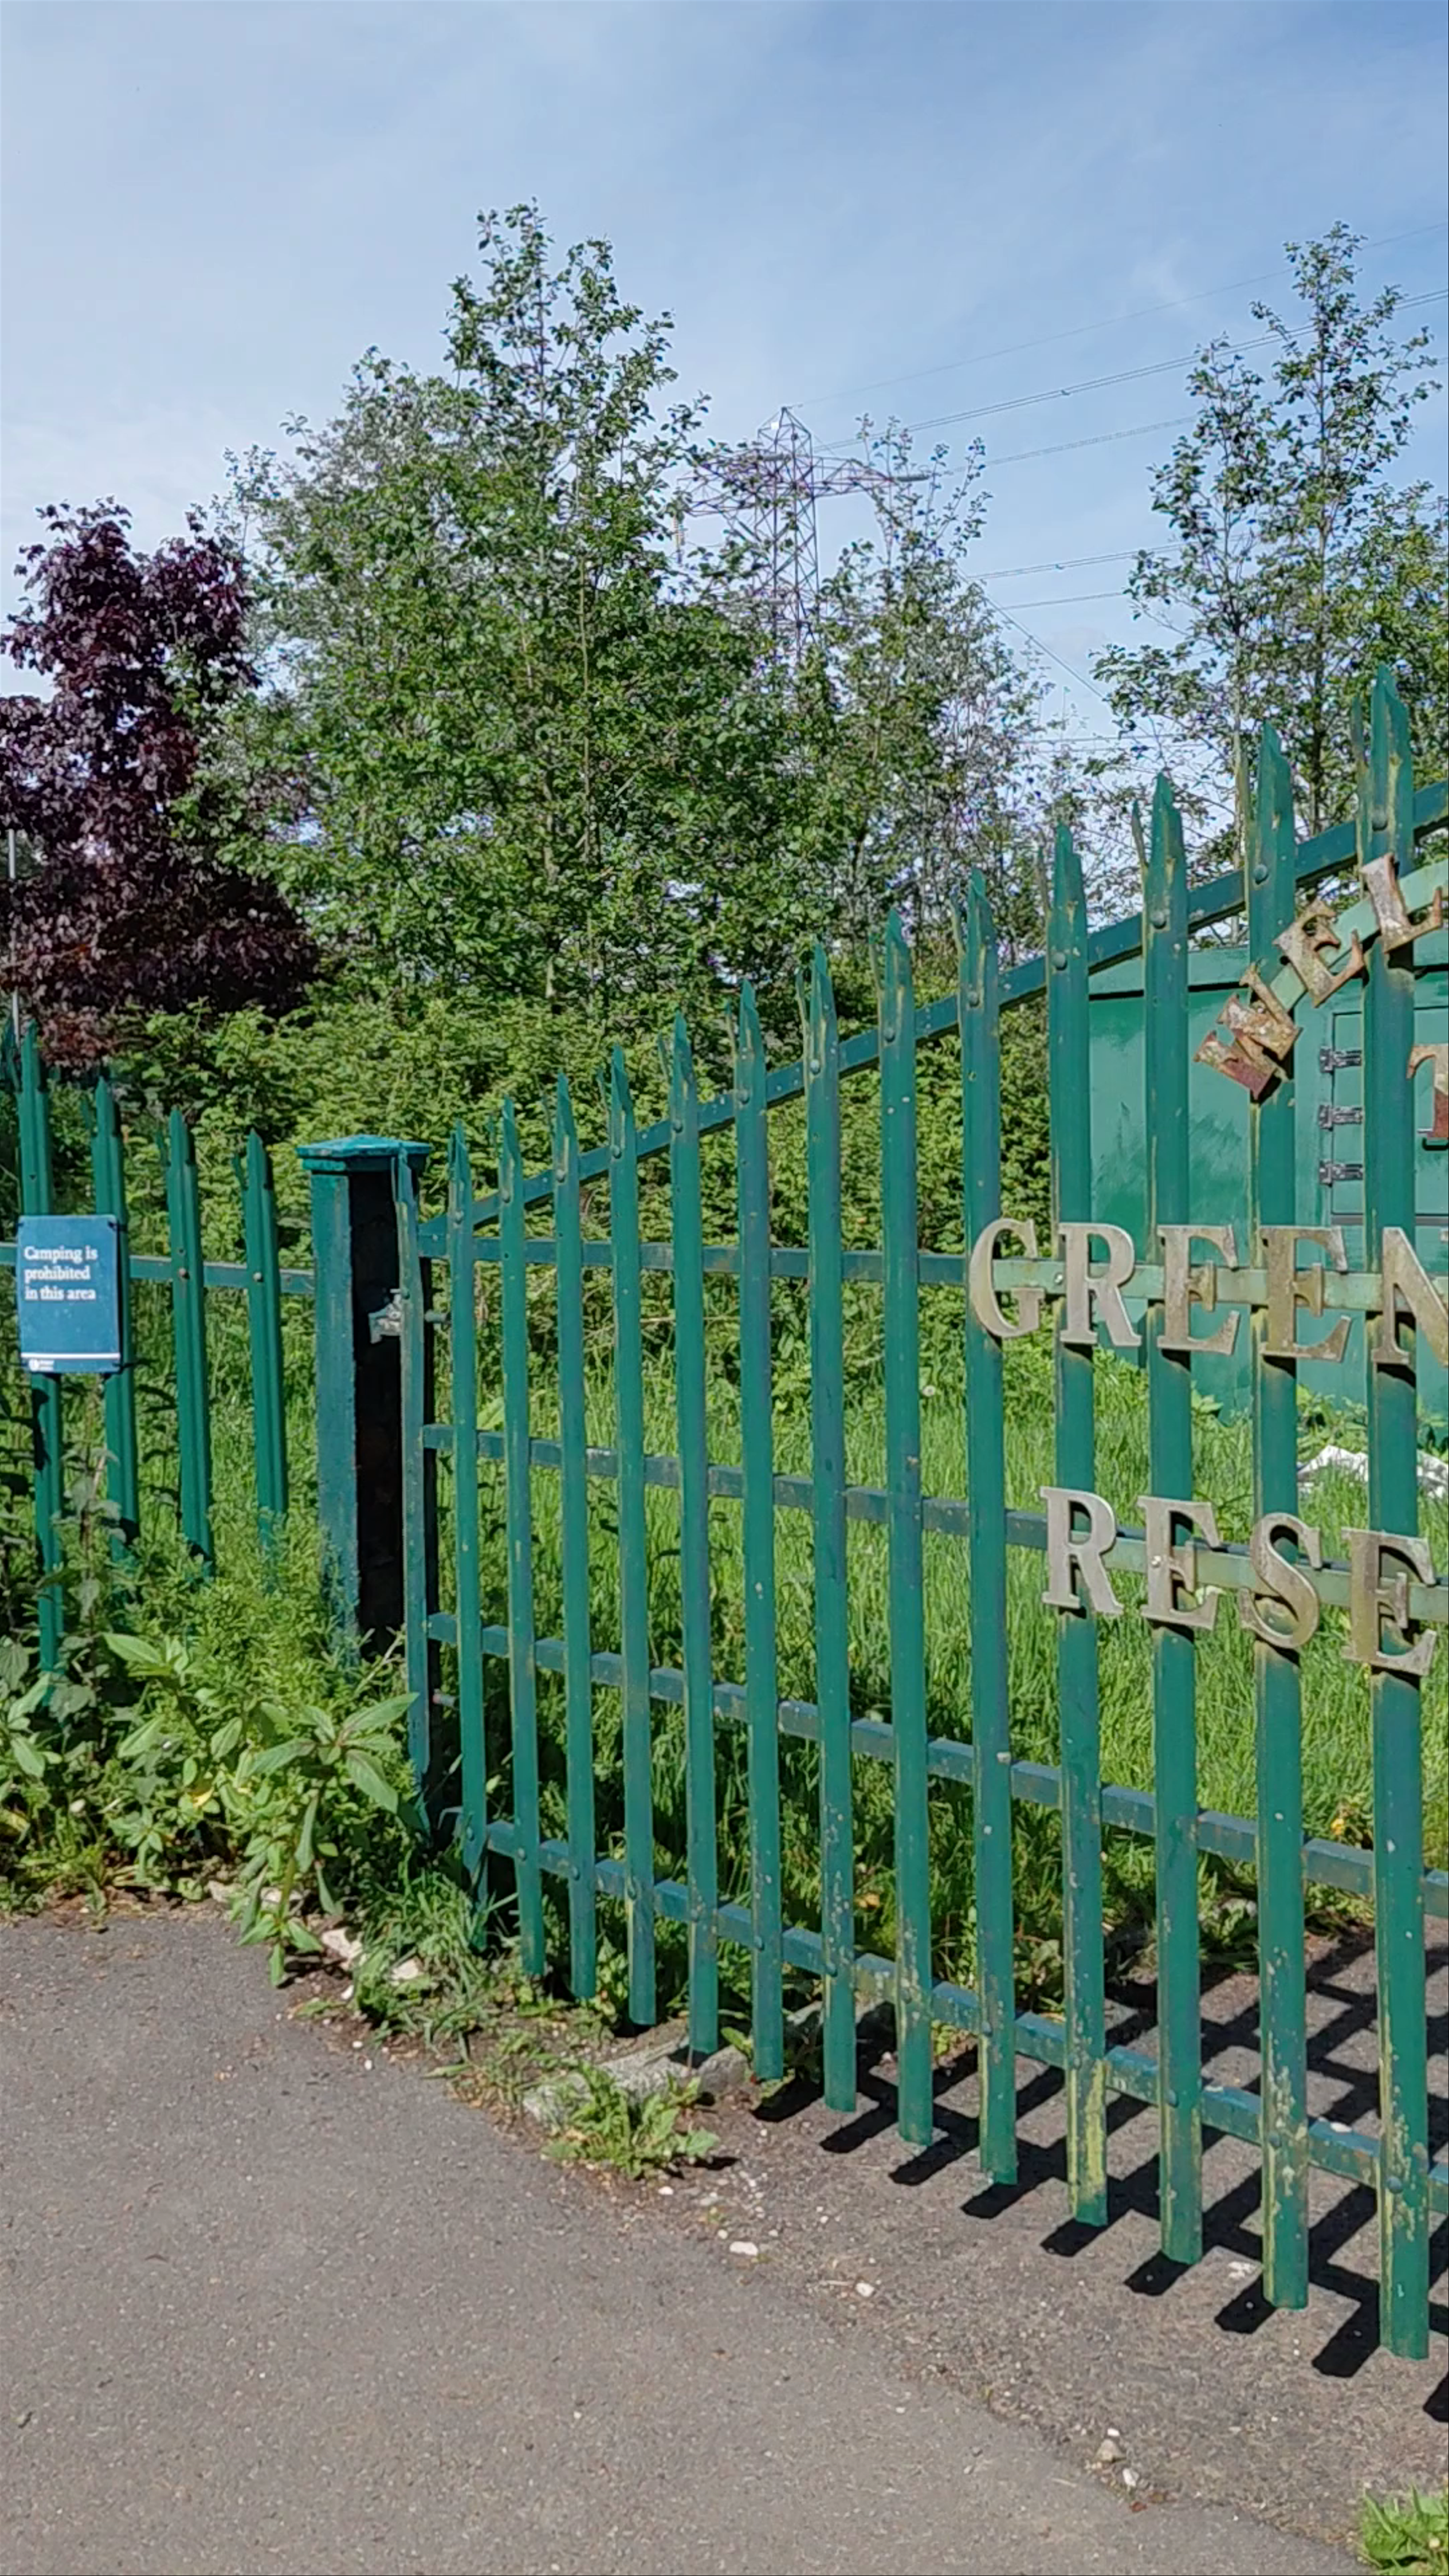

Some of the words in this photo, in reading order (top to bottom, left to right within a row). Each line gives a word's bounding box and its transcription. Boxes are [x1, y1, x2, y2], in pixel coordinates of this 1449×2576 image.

[25, 1245, 83, 1264] Camping
[85, 1245, 98, 1260] is
[24, 1265, 90, 1283] prohibited
[24, 1286, 38, 1299] in
[40, 1285, 64, 1299] this
[67, 1289, 96, 1299] area
[970, 1218, 1449, 1369] GREEN
[1040, 1486, 1437, 1676] RESE
